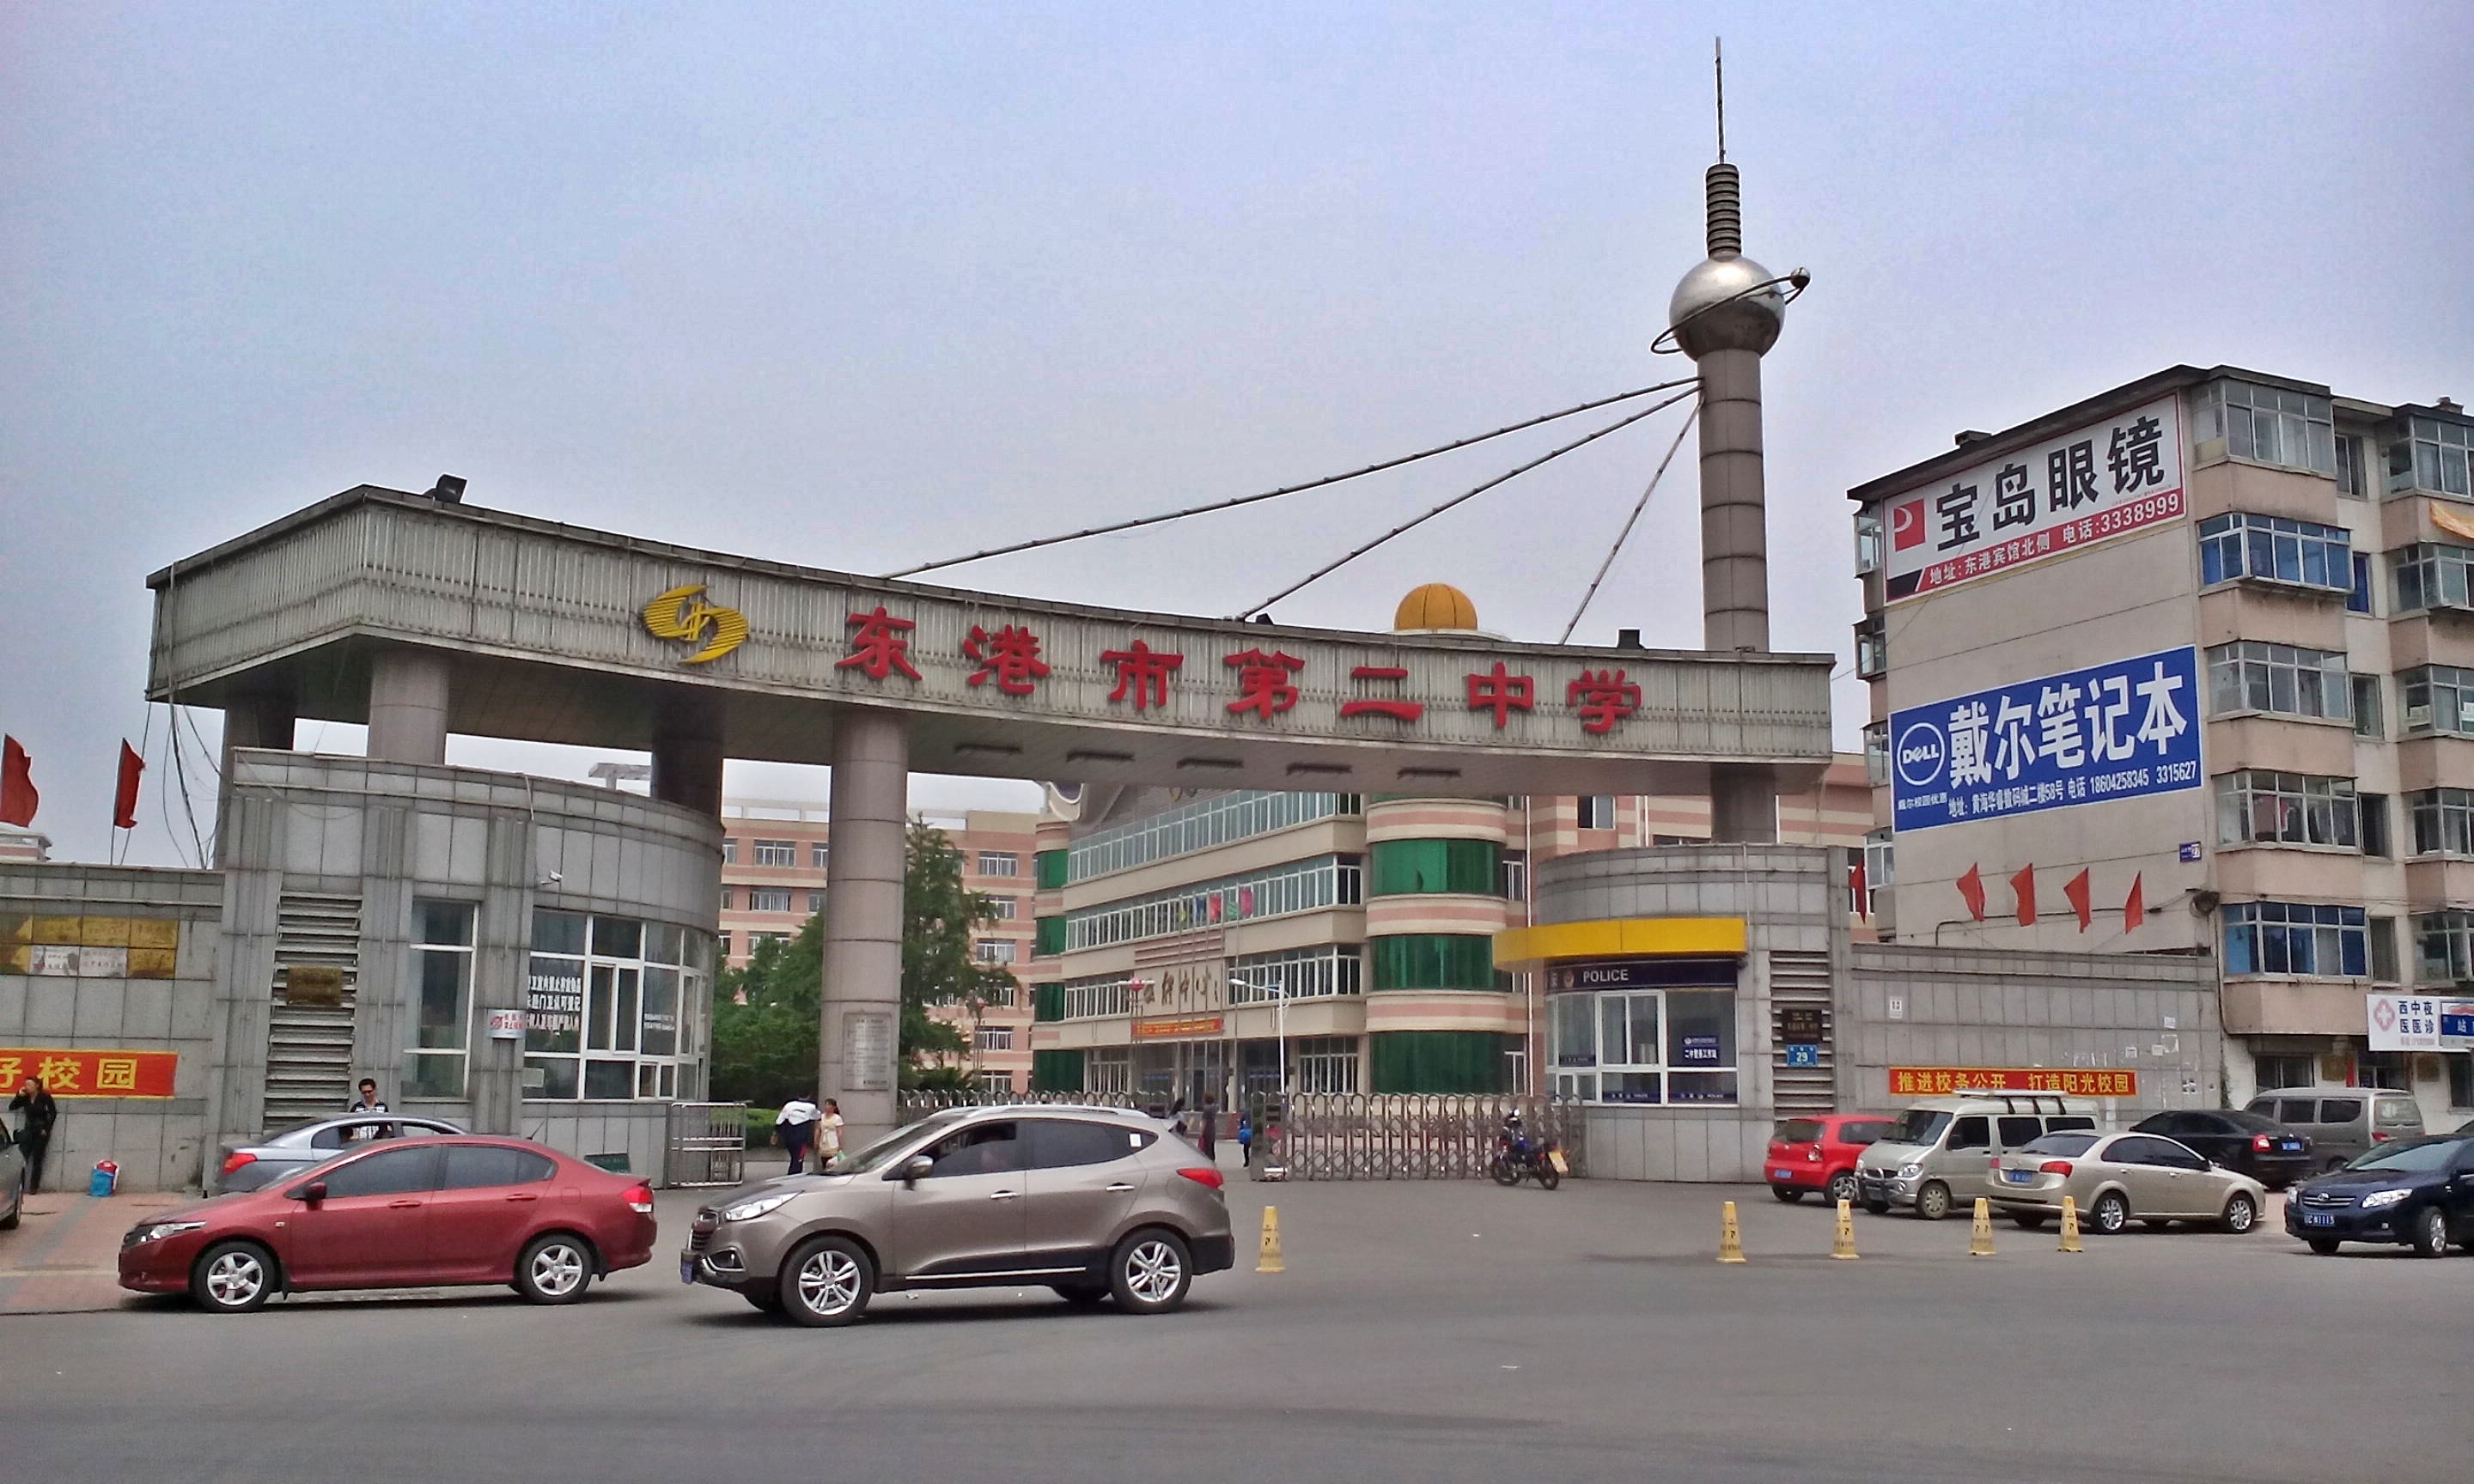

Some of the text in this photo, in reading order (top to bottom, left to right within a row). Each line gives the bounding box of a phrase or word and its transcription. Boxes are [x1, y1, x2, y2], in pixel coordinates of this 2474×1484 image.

[1935, 416, 2165, 551] 宝岛眼镜
[2063, 492, 2179, 544] 电话:3338999
[834, 605, 1642, 733] 东港市第二中学
[1948, 660, 2188, 789] 戴尔笔记本
[1902, 743, 1940, 765] DELL
[2068, 775, 2087, 799] 电话
[2090, 768, 2149, 794] 18604258345
[2156, 761, 2197, 785] 3315627
[1582, 969, 1630, 983] POLICE
[1795, 1051, 1808, 1062] 29
[1898, 1070, 2130, 1092] 推进校务公开 打造阳光校园
